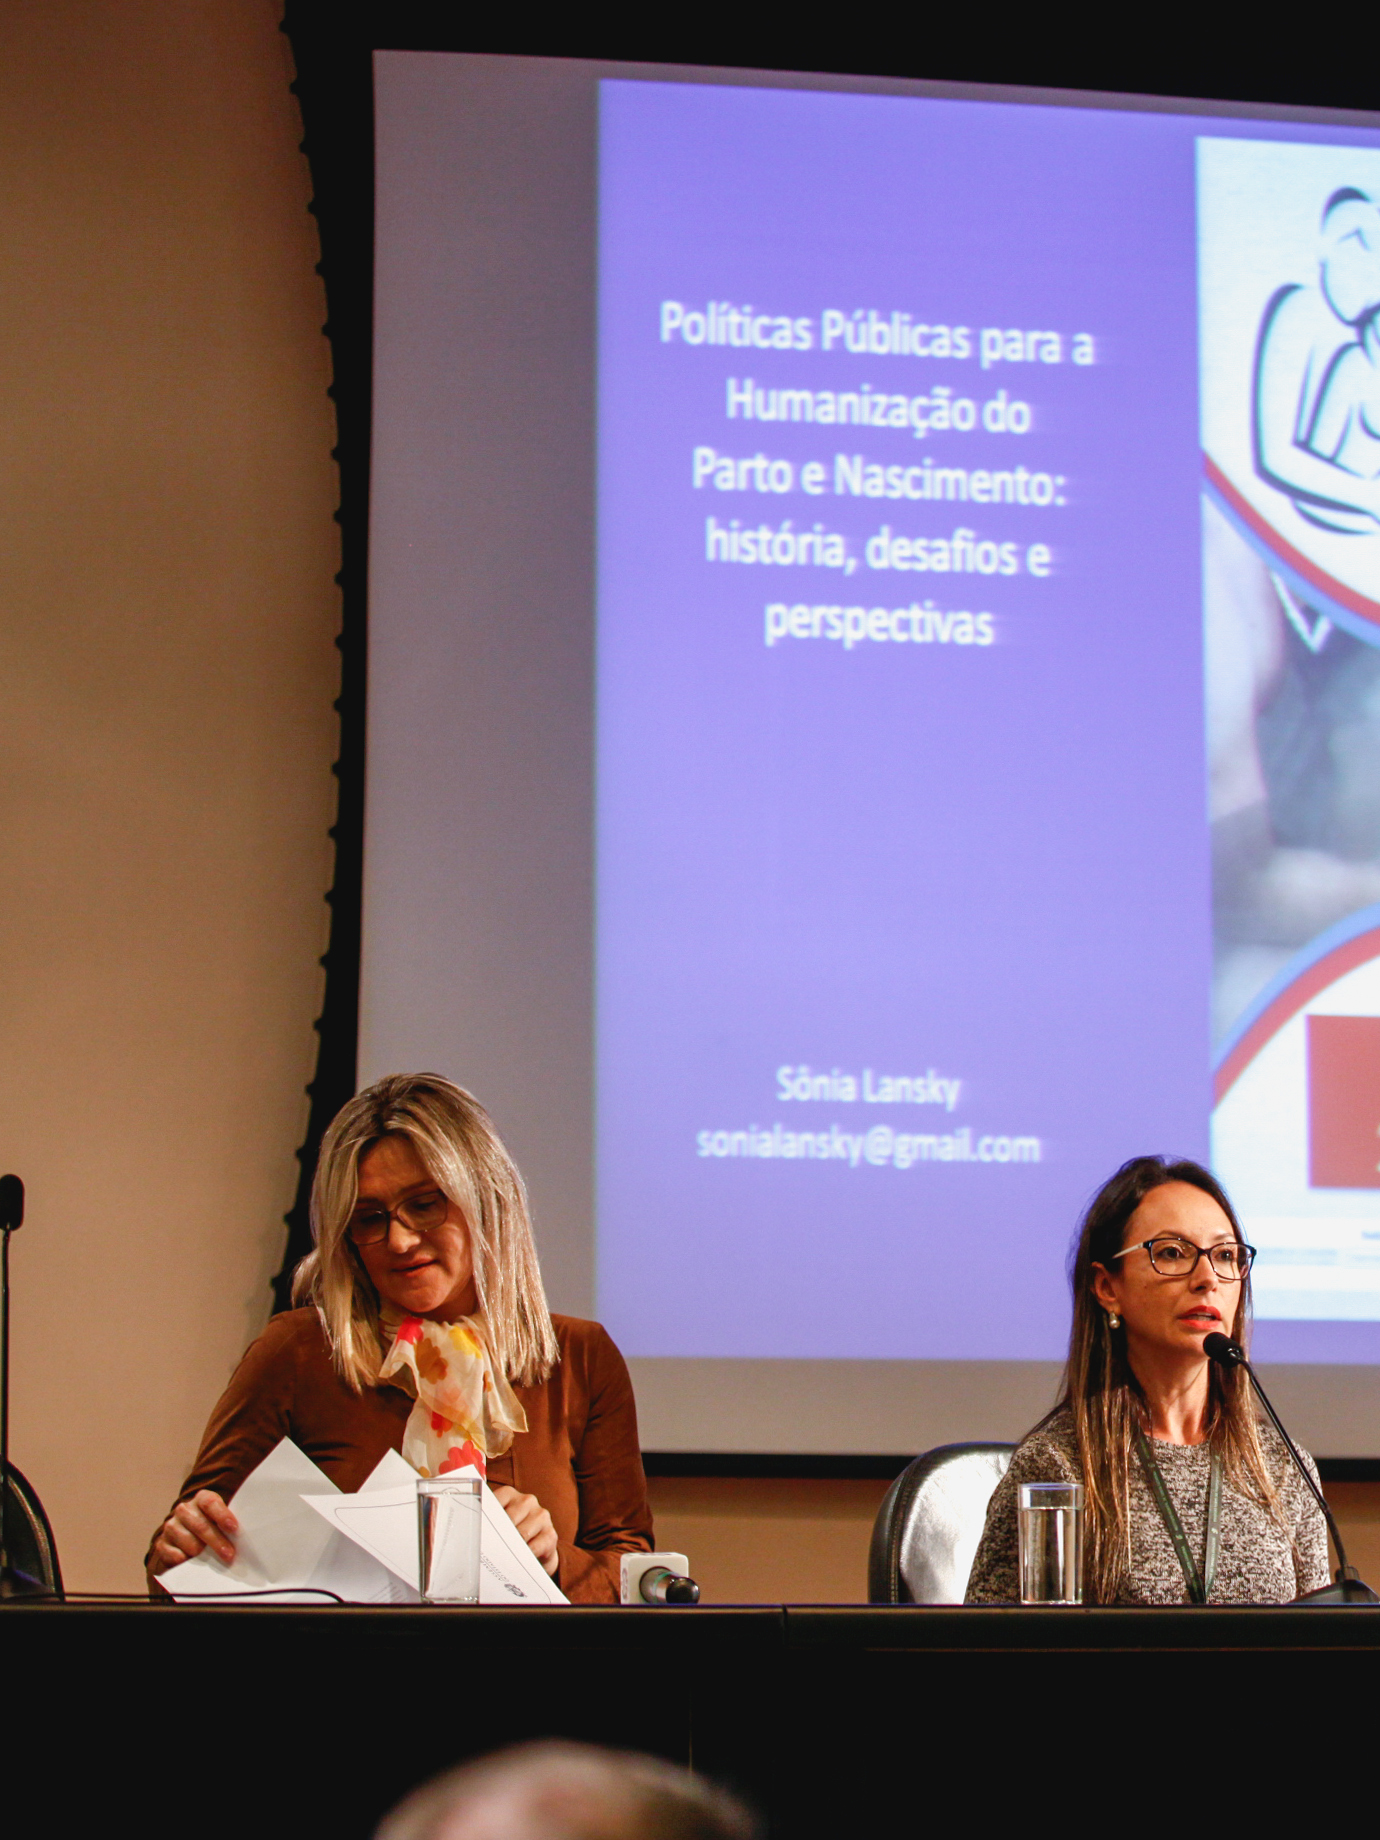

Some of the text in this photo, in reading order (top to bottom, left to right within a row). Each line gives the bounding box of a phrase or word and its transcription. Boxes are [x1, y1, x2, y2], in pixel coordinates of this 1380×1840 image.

[661, 301, 1095, 369] Políticas Públicas para a
[726, 377, 1031, 438] Humanização do
[693, 446, 1066, 506] Parto e Nascimento:
[706, 516, 1051, 576] história, desafios e
[765, 600, 993, 650] perspectivas
[862, 1067, 962, 1113] Lansky
[697, 1122, 1041, 1169] sonialansky@gmail.com
